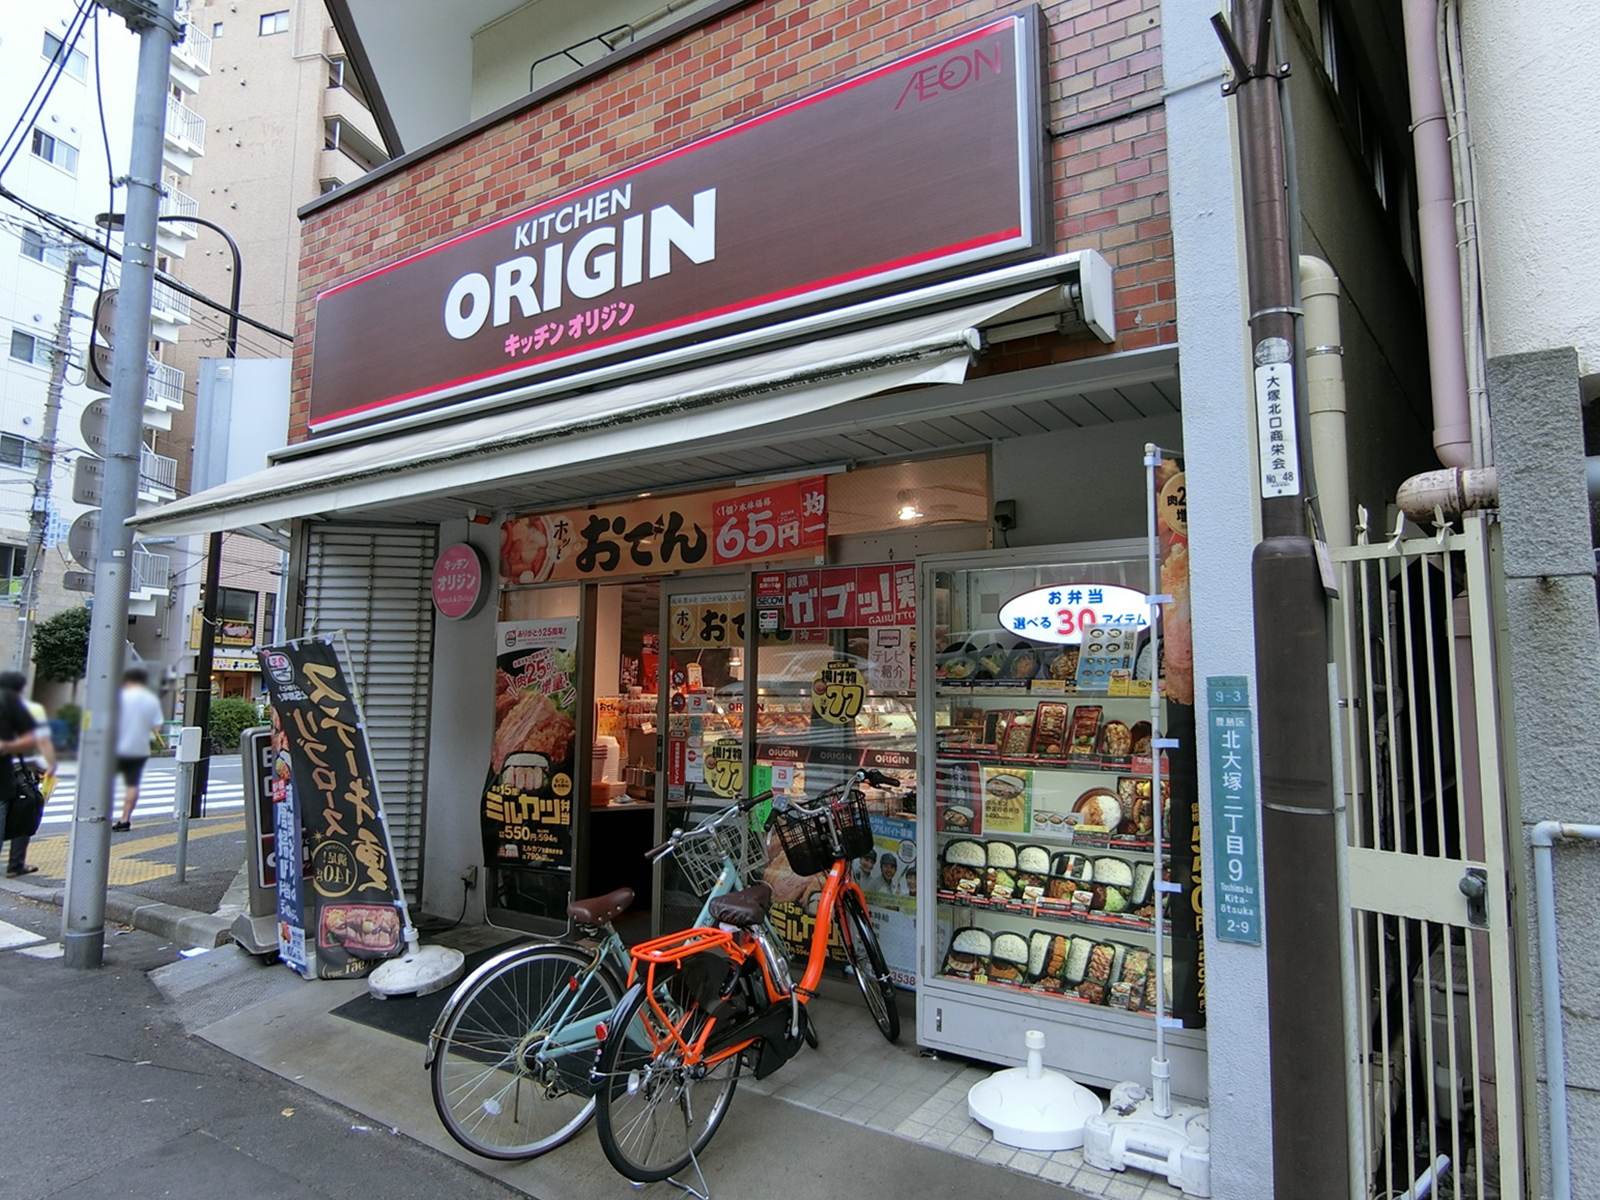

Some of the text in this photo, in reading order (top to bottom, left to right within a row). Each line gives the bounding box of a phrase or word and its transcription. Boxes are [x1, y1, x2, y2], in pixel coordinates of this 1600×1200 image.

[514, 183, 632, 250] KITCHEN
[444, 187, 717, 340] ORIGIN
[1266, 375, 1286, 471] 大塚北口商栄会
[1282, 471, 1294, 482] 48
[803, 490, 826, 533] 均一
[716, 509, 800, 558] 65円
[576, 511, 708, 573] おでん
[444, 558, 469, 571] キッチン
[437, 573, 476, 591] オリジン
[758, 597, 783, 606] SECOM
[1048, 588, 1104, 605] お弁当
[873, 650, 905, 664] テレビ
[821, 670, 857, 684] 揚げ物
[1215, 690, 1242, 702] 9-3
[1215, 717, 1246, 727] 豊島区
[768, 748, 799, 758] ORIGIN
[874, 754, 910, 765] ORIGIN
[1226, 919, 1250, 934] 2-9
